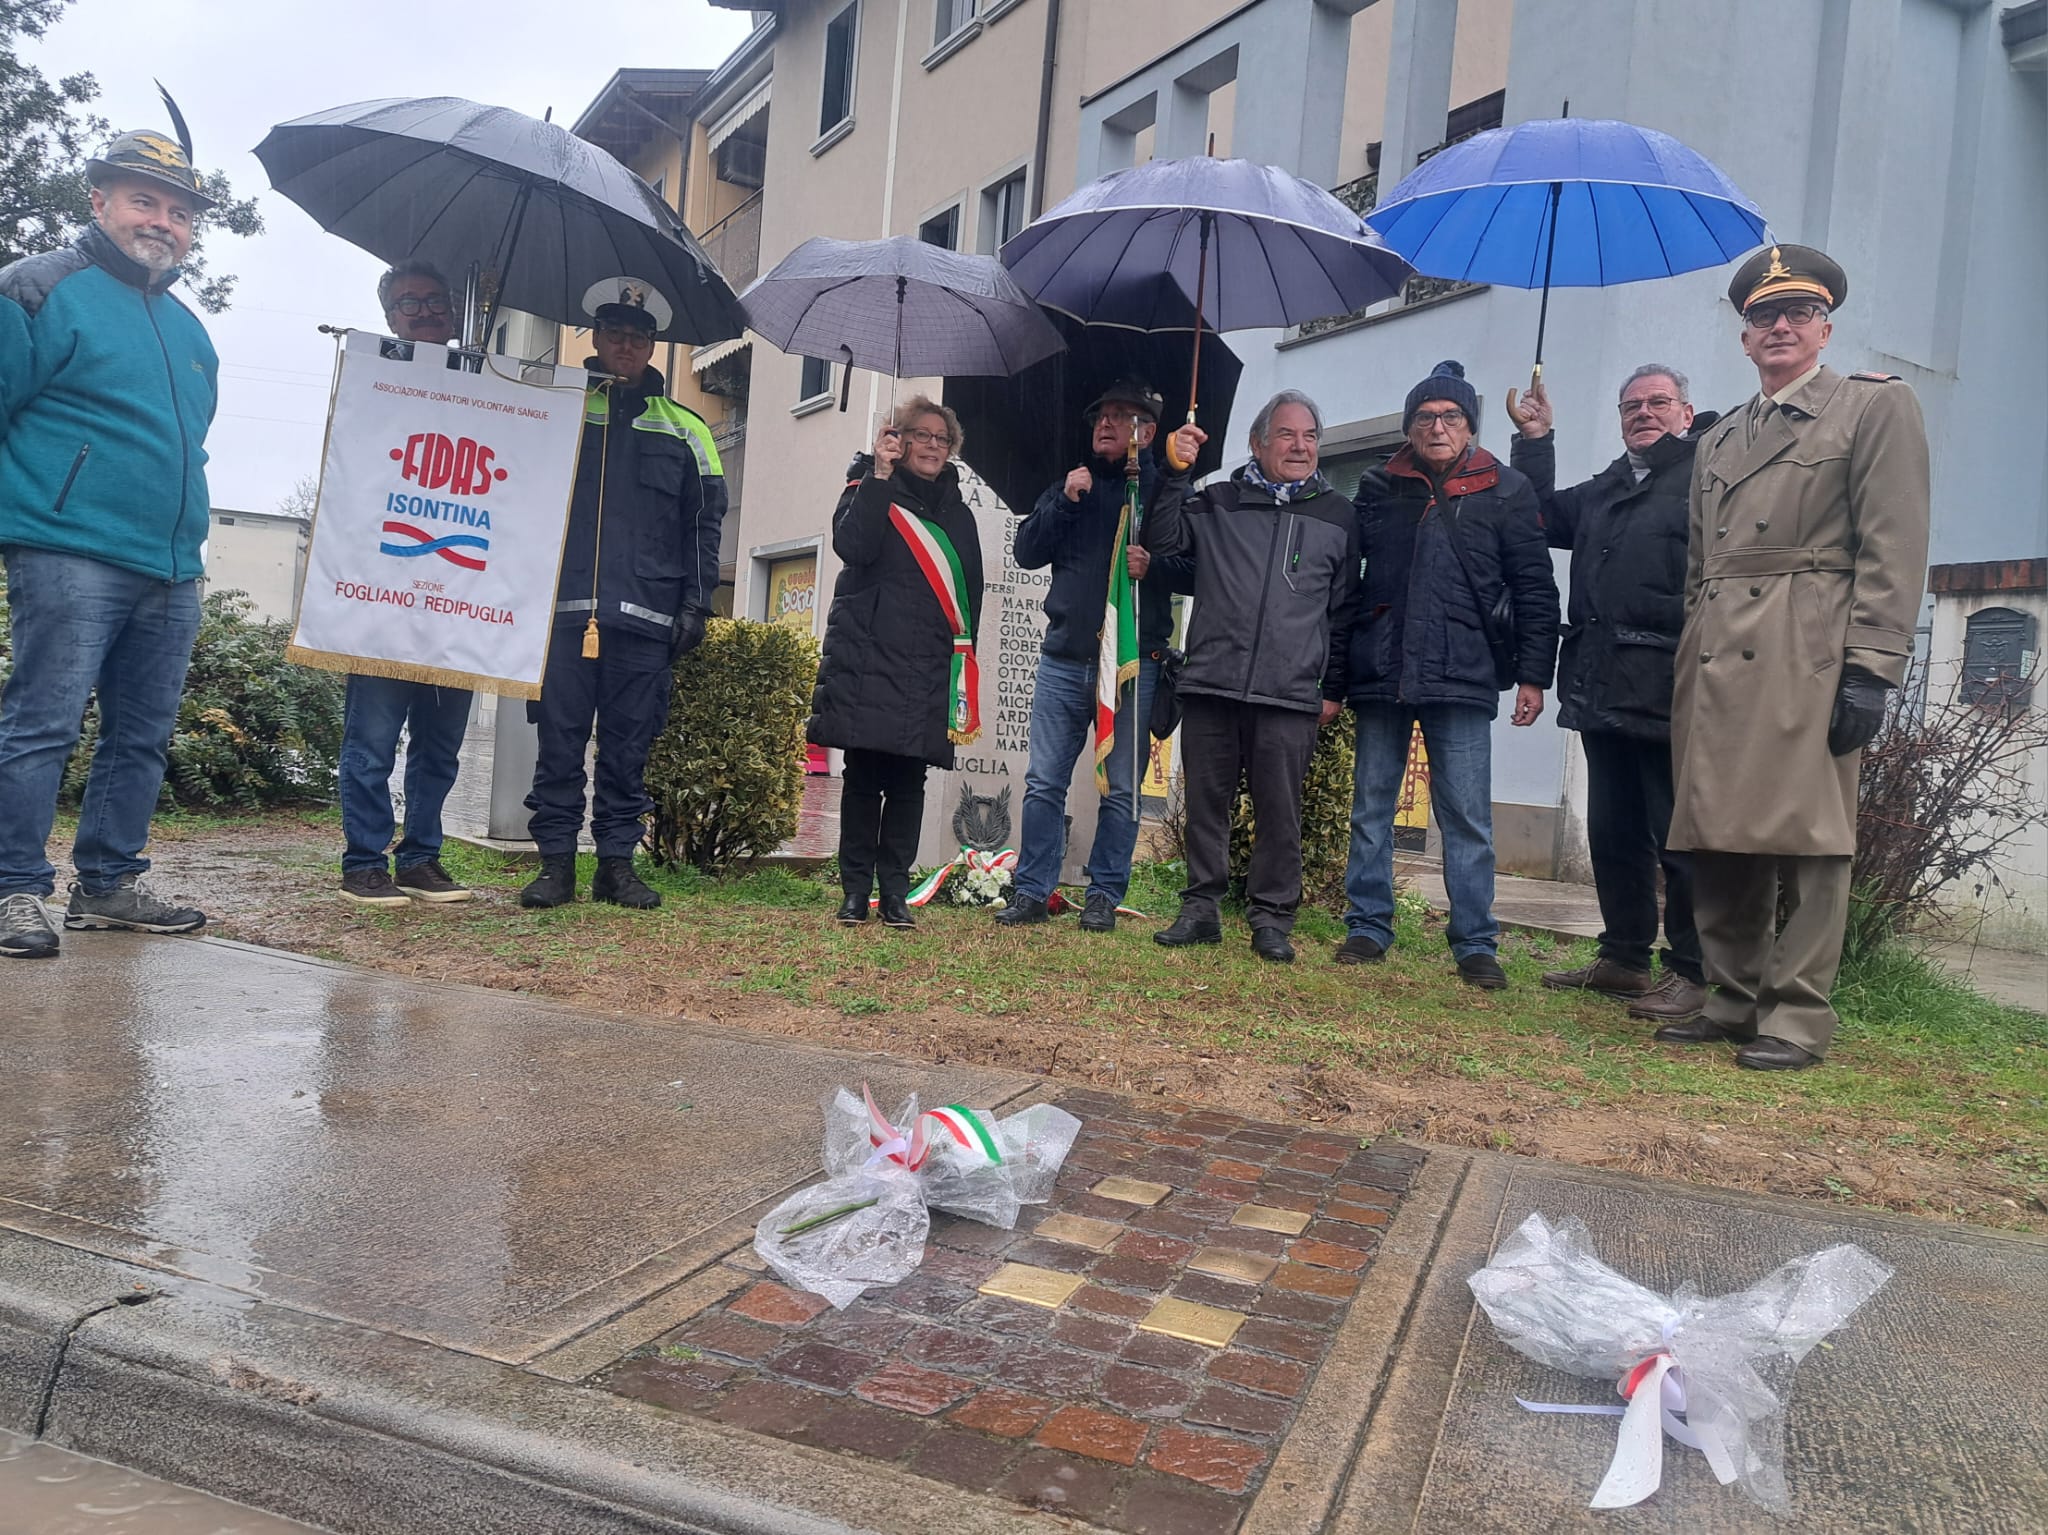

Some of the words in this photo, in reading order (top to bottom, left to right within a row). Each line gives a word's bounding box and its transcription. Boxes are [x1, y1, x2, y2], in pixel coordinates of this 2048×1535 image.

[373, 381, 428, 398] ASSOCIAZIONE
[430, 391, 469, 406] DONATORI
[472, 399, 516, 414] VOLONTARI
[517, 407, 549, 420] SANGUE
[402, 433, 495, 495] FIDAS
[387, 493, 491, 530] ISONTINA
[412, 579, 445, 593] SEZIONE
[1003, 571, 1052, 587] ISIDOR
[985, 583, 1015, 594] PERSI
[336, 581, 415, 608] FOGLIANO
[424, 595, 514, 625] REDIPUGLIA
[1001, 611, 1032, 625] ZITA
[1000, 625, 1043, 640] GIOVA
[1000, 638, 1042, 653] ROBE
[998, 681, 1033, 695] GIAC
[997, 695, 1033, 710] MICH
[995, 739, 1029, 753] MAR
